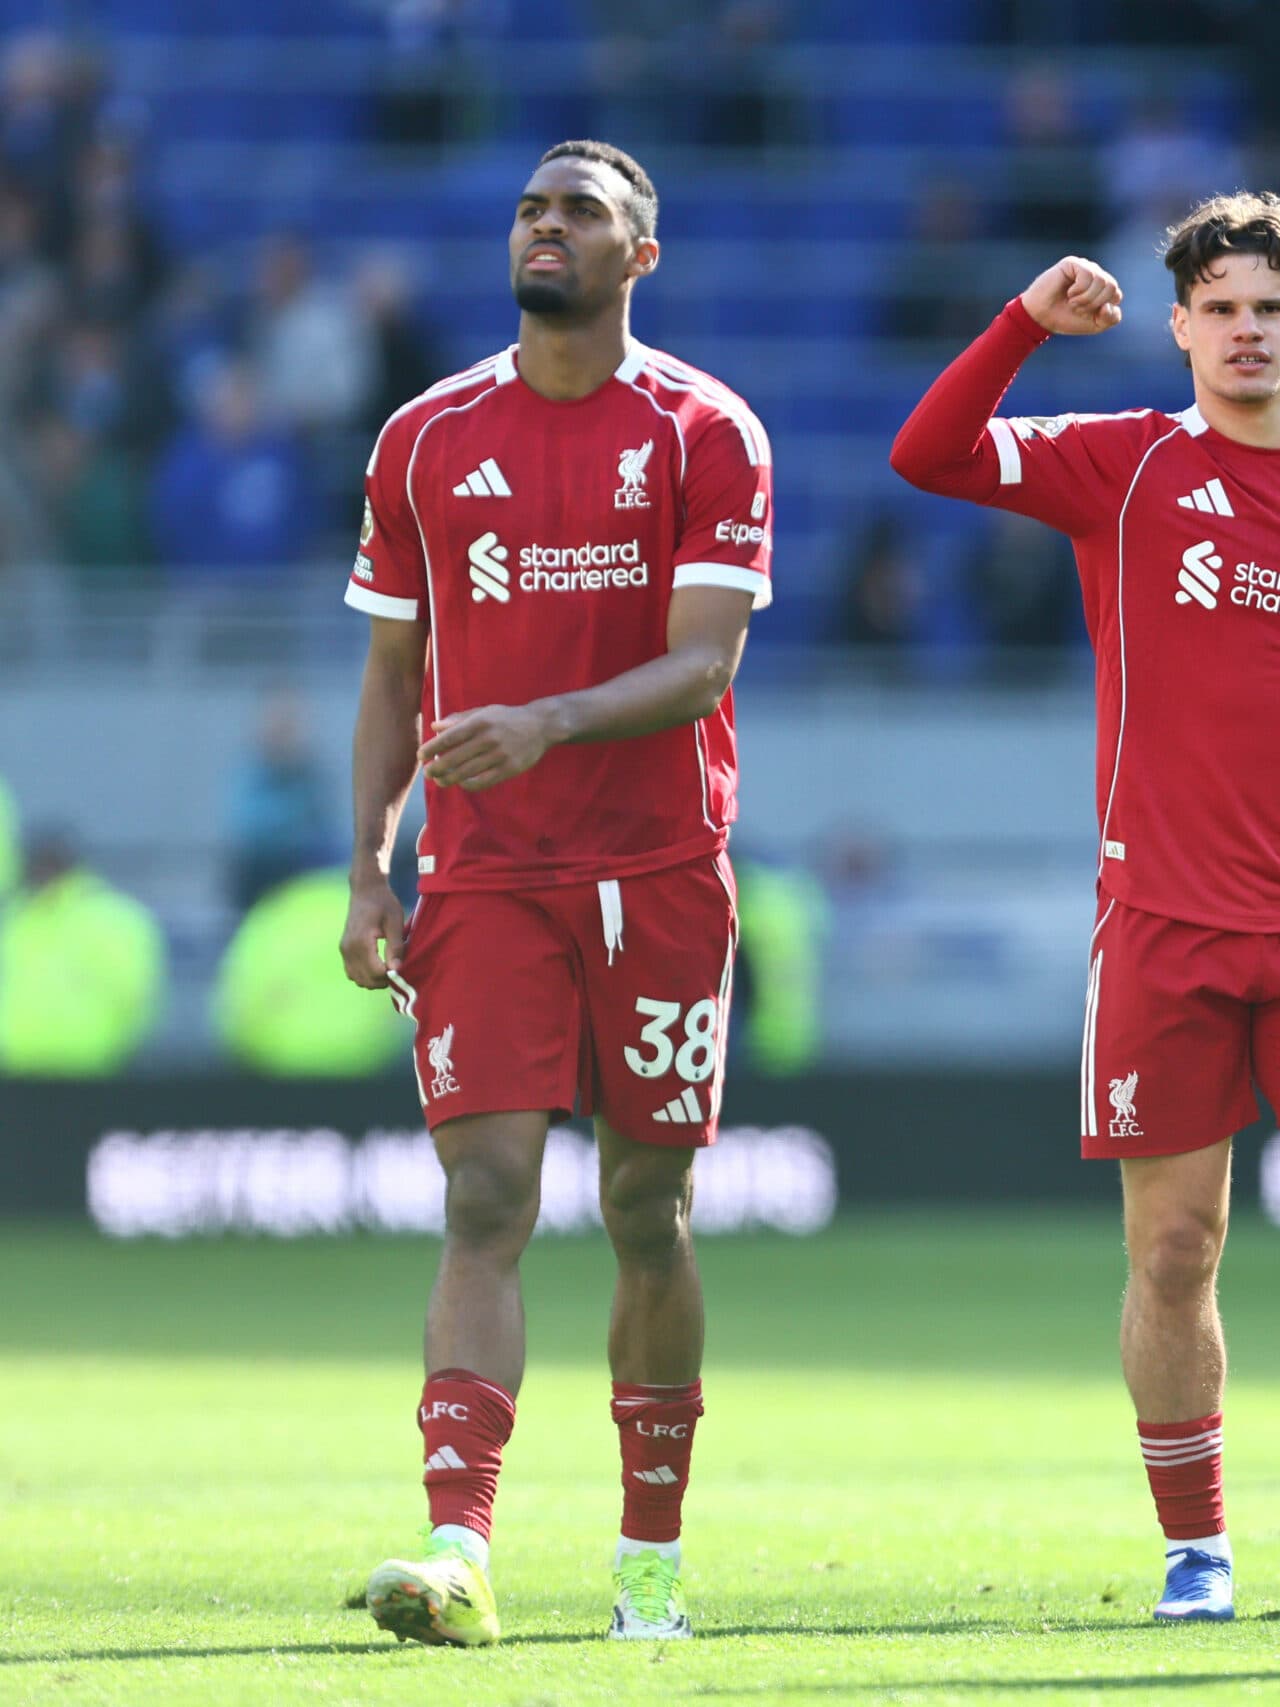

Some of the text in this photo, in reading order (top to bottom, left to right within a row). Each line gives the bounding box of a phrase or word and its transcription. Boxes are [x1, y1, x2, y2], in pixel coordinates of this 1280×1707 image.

[519, 539, 638, 568] standard
[519, 562, 648, 591] chartered
[624, 996, 716, 1082] 38
[420, 1401, 468, 1422] LFC
[636, 1420, 688, 1439] LFC
